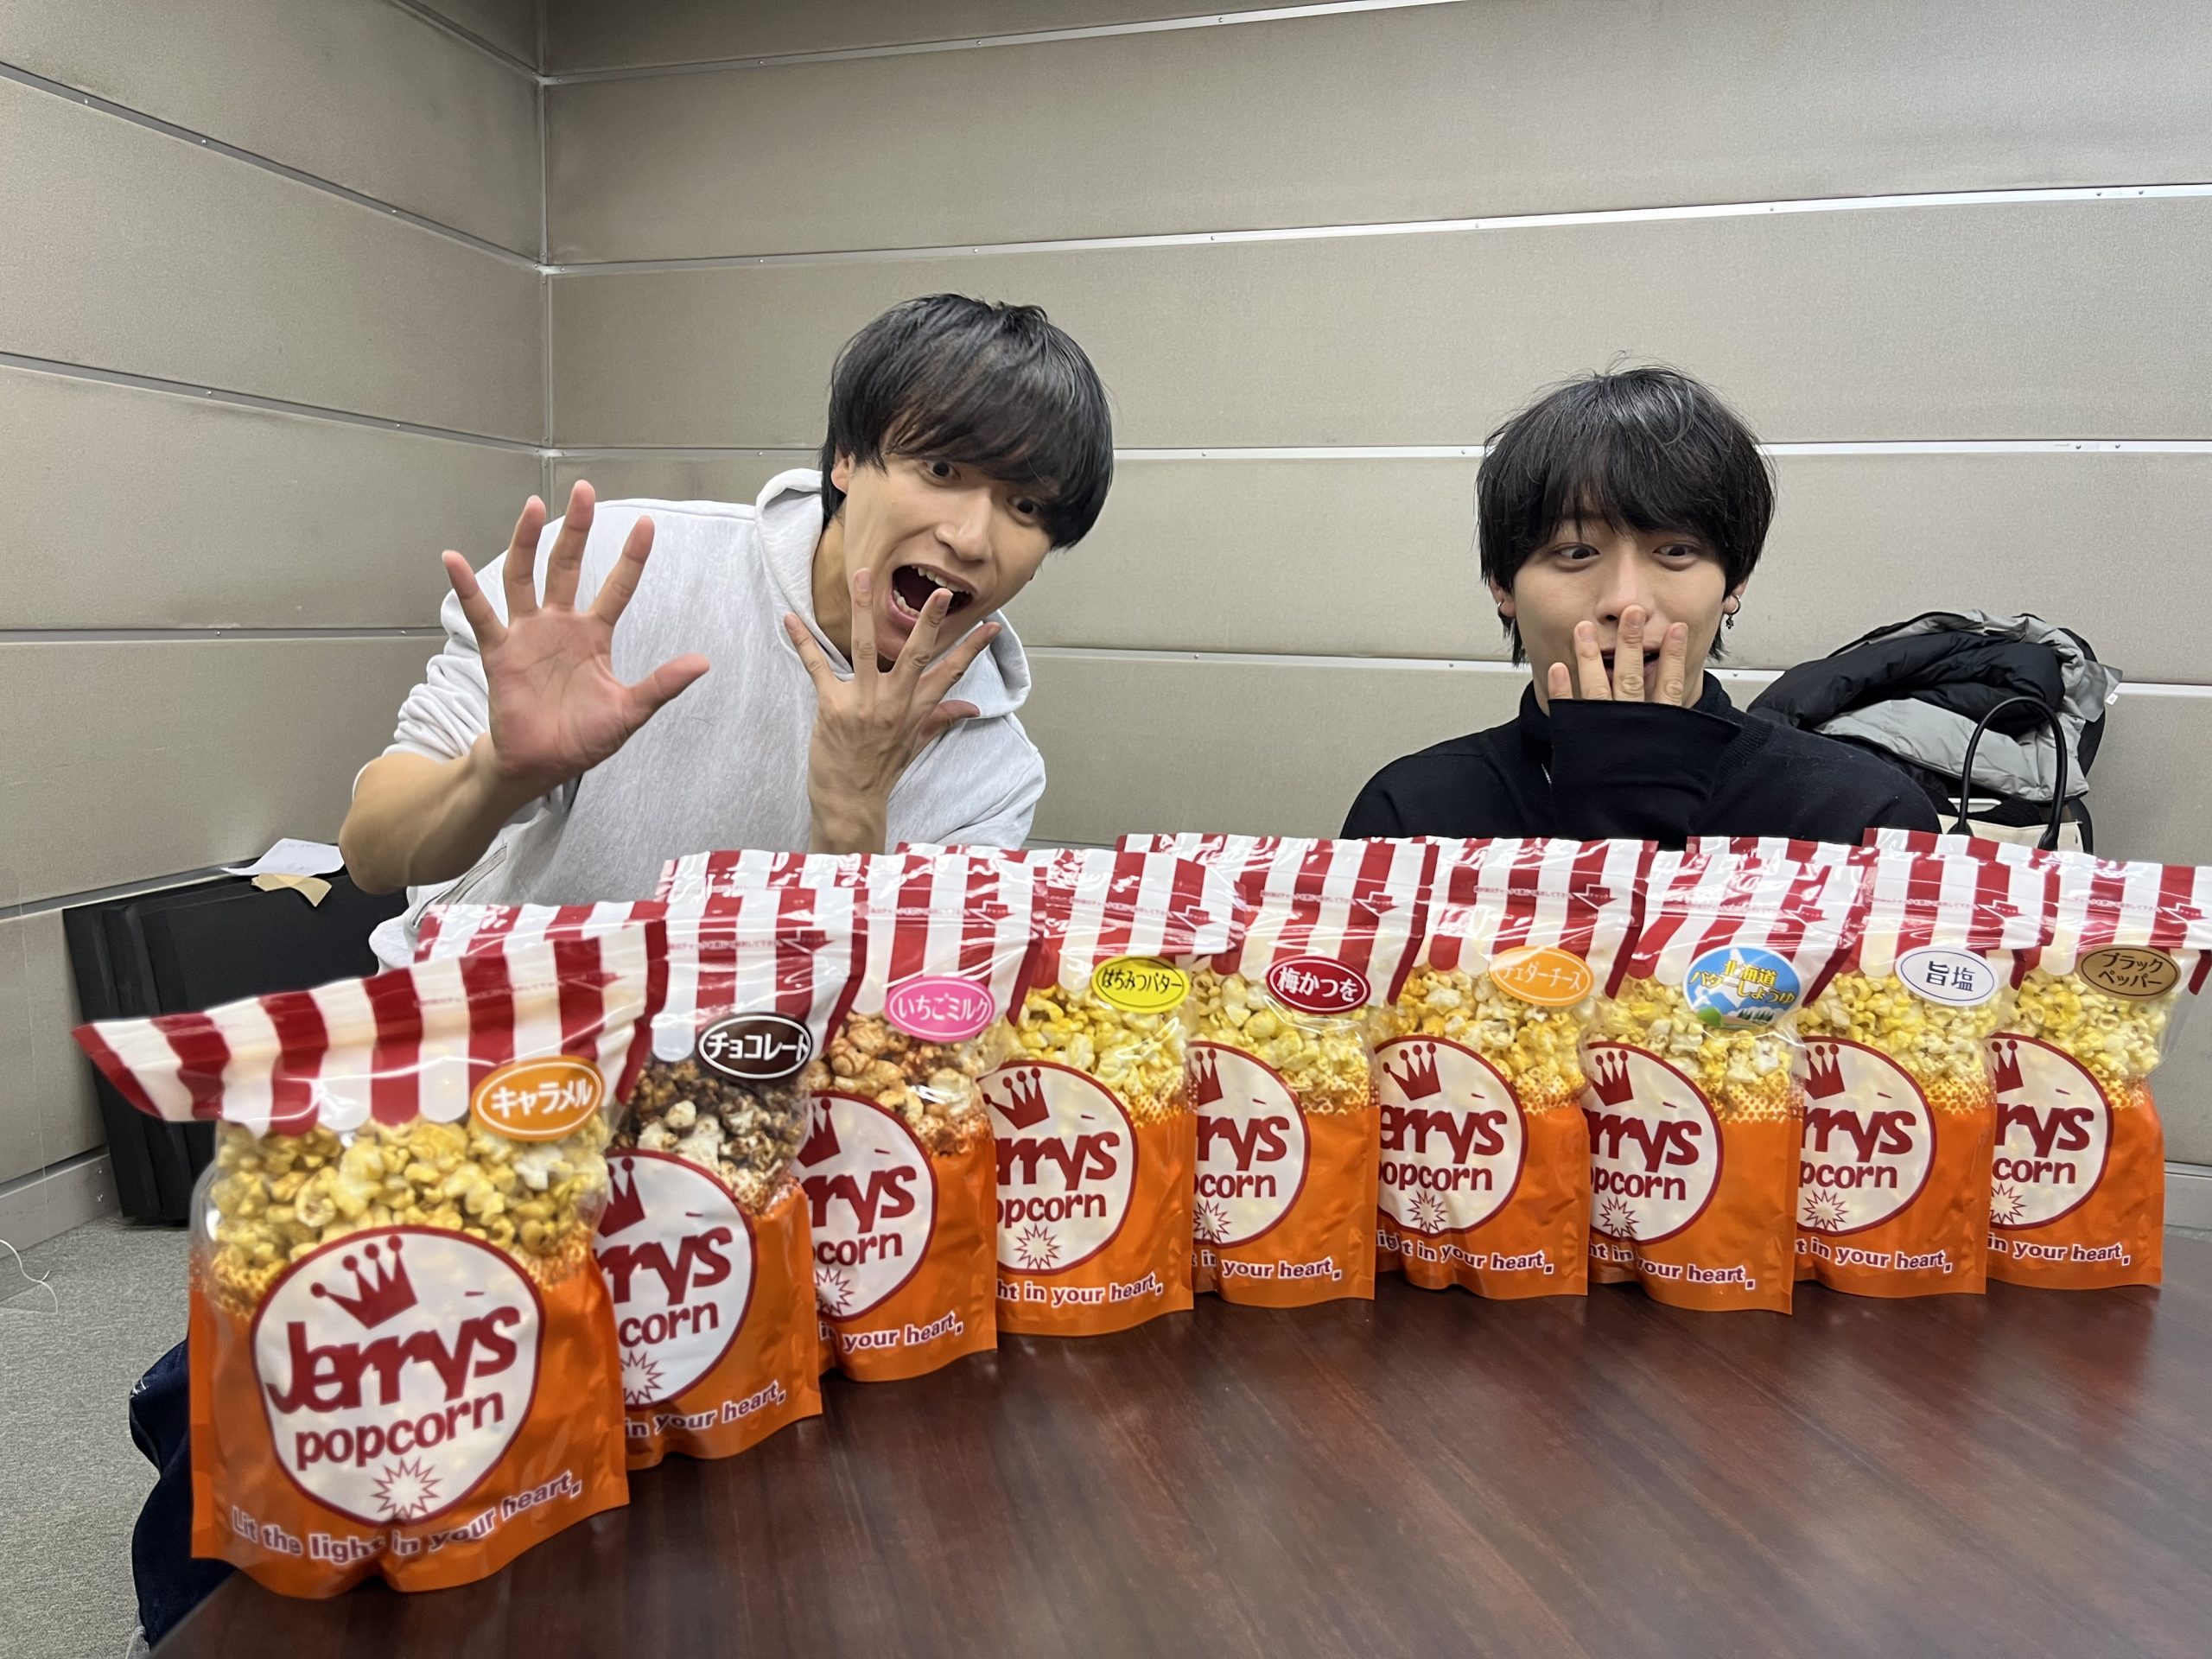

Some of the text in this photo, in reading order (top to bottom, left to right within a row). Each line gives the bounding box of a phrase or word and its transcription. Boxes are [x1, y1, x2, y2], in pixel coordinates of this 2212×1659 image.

[1723, 959, 1778, 988] 北海道
[1925, 960, 1976, 992] 旨塩
[2102, 952, 2164, 974] ブラック
[1101, 967, 1182, 995] はちみつバター
[1276, 966, 1358, 1002] 梅かつを
[2097, 969, 2163, 988] ペッパー
[898, 992, 988, 1023] いちごミルク
[706, 1031, 810, 1062] チョコレート
[491, 1077, 594, 1119] キャラメル
[1377, 1160, 1493, 1192] opcorn
[1591, 1166, 1686, 1201] pcorn
[1798, 1160, 1897, 1189] pcorn
[1992, 1157, 2076, 1185] corn
[1194, 1173, 1276, 1199] corn
[996, 1193, 1107, 1229] pcorn
[813, 1232, 903, 1267] corn
[1417, 1241, 1437, 1262] in
[1440, 1244, 1487, 1268] your
[1612, 1245, 1634, 1262] in
[1811, 1237, 1831, 1259] in
[1835, 1247, 1891, 1268] your
[1987, 1233, 2008, 1253] in
[2013, 1242, 2068, 1260] your
[1222, 1259, 1274, 1279] your
[1024, 1281, 1046, 1302] in
[1051, 1286, 1105, 1308] your
[619, 1301, 719, 1348] corn
[842, 1330, 900, 1354] your
[296, 1391, 505, 1471] popcorn
[653, 1409, 718, 1435] your
[232, 1507, 258, 1542] Lit
[263, 1523, 302, 1557] the
[391, 1529, 421, 1556] in
[428, 1506, 497, 1553] your
